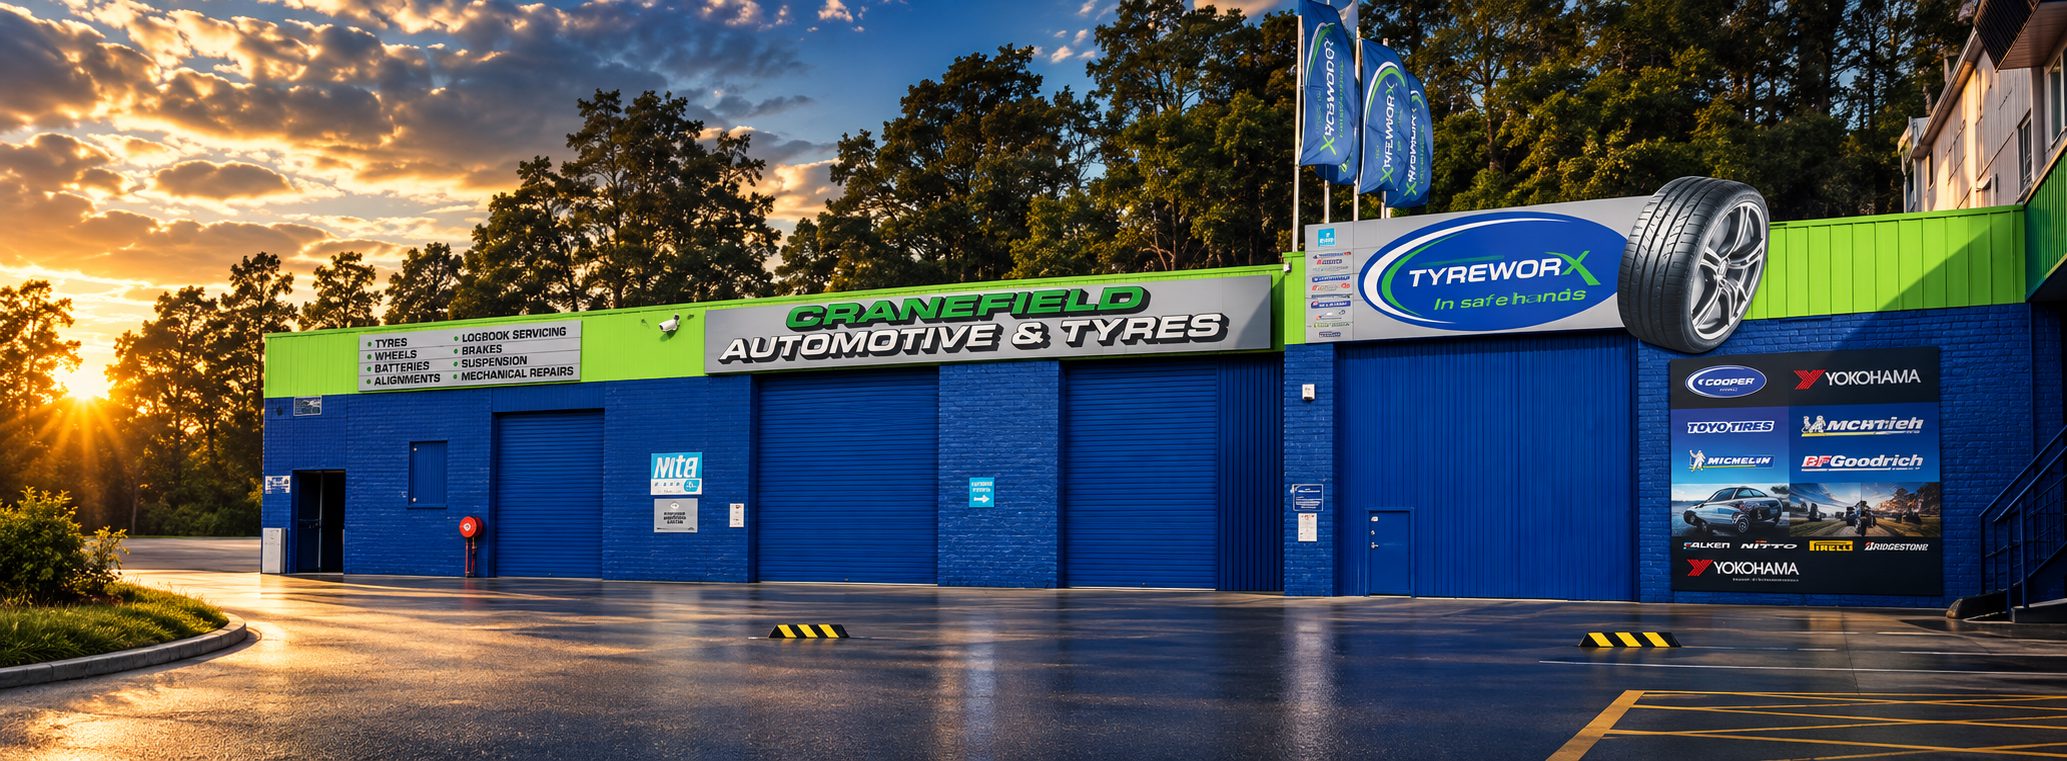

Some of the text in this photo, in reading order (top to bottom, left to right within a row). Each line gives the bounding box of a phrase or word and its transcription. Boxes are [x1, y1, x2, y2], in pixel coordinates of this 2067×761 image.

[1409, 250, 1600, 287] TYREWORX
[1434, 288, 1586, 310] In safe hands
[785, 286, 1148, 329] CRANEFIELD
[462, 327, 566, 343] LOGBOOK SERVICING
[718, 313, 1226, 361] AUTOMOTIVE & TYRES
[375, 337, 407, 348] TYRES
[462, 344, 502, 355] BRAKES
[375, 349, 417, 361] WHEELS
[461, 355, 527, 368] SUSPENSION
[374, 361, 430, 374] BATTERIES
[461, 366, 574, 381] MECHANICAL REPAIRS
[374, 373, 441, 386] ALIGNMENTS
[1704, 377, 1755, 386] COOPER
[1825, 369, 1921, 386] YOKOHAMA
[1687, 421, 1775, 434] TOYO TIRES
[1801, 454, 1924, 468] BFGoodrich
[1713, 561, 1800, 575] YOKOHAMA
